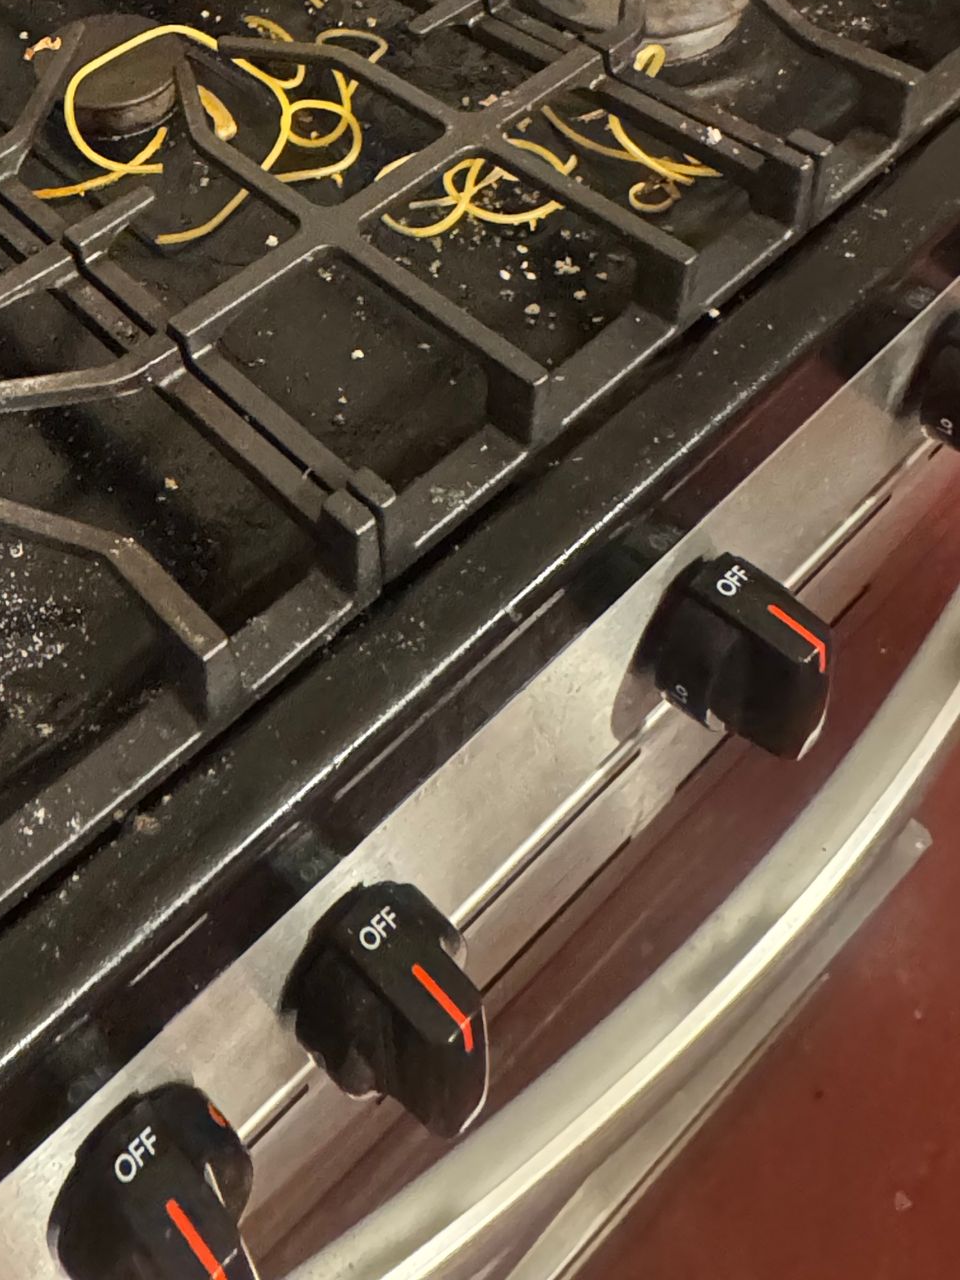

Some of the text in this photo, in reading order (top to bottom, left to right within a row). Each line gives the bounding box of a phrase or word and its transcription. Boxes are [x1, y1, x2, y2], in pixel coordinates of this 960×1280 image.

[716, 565, 751, 597] OFF
[359, 906, 397, 951] OFF
[114, 1127, 158, 1183] OFF
